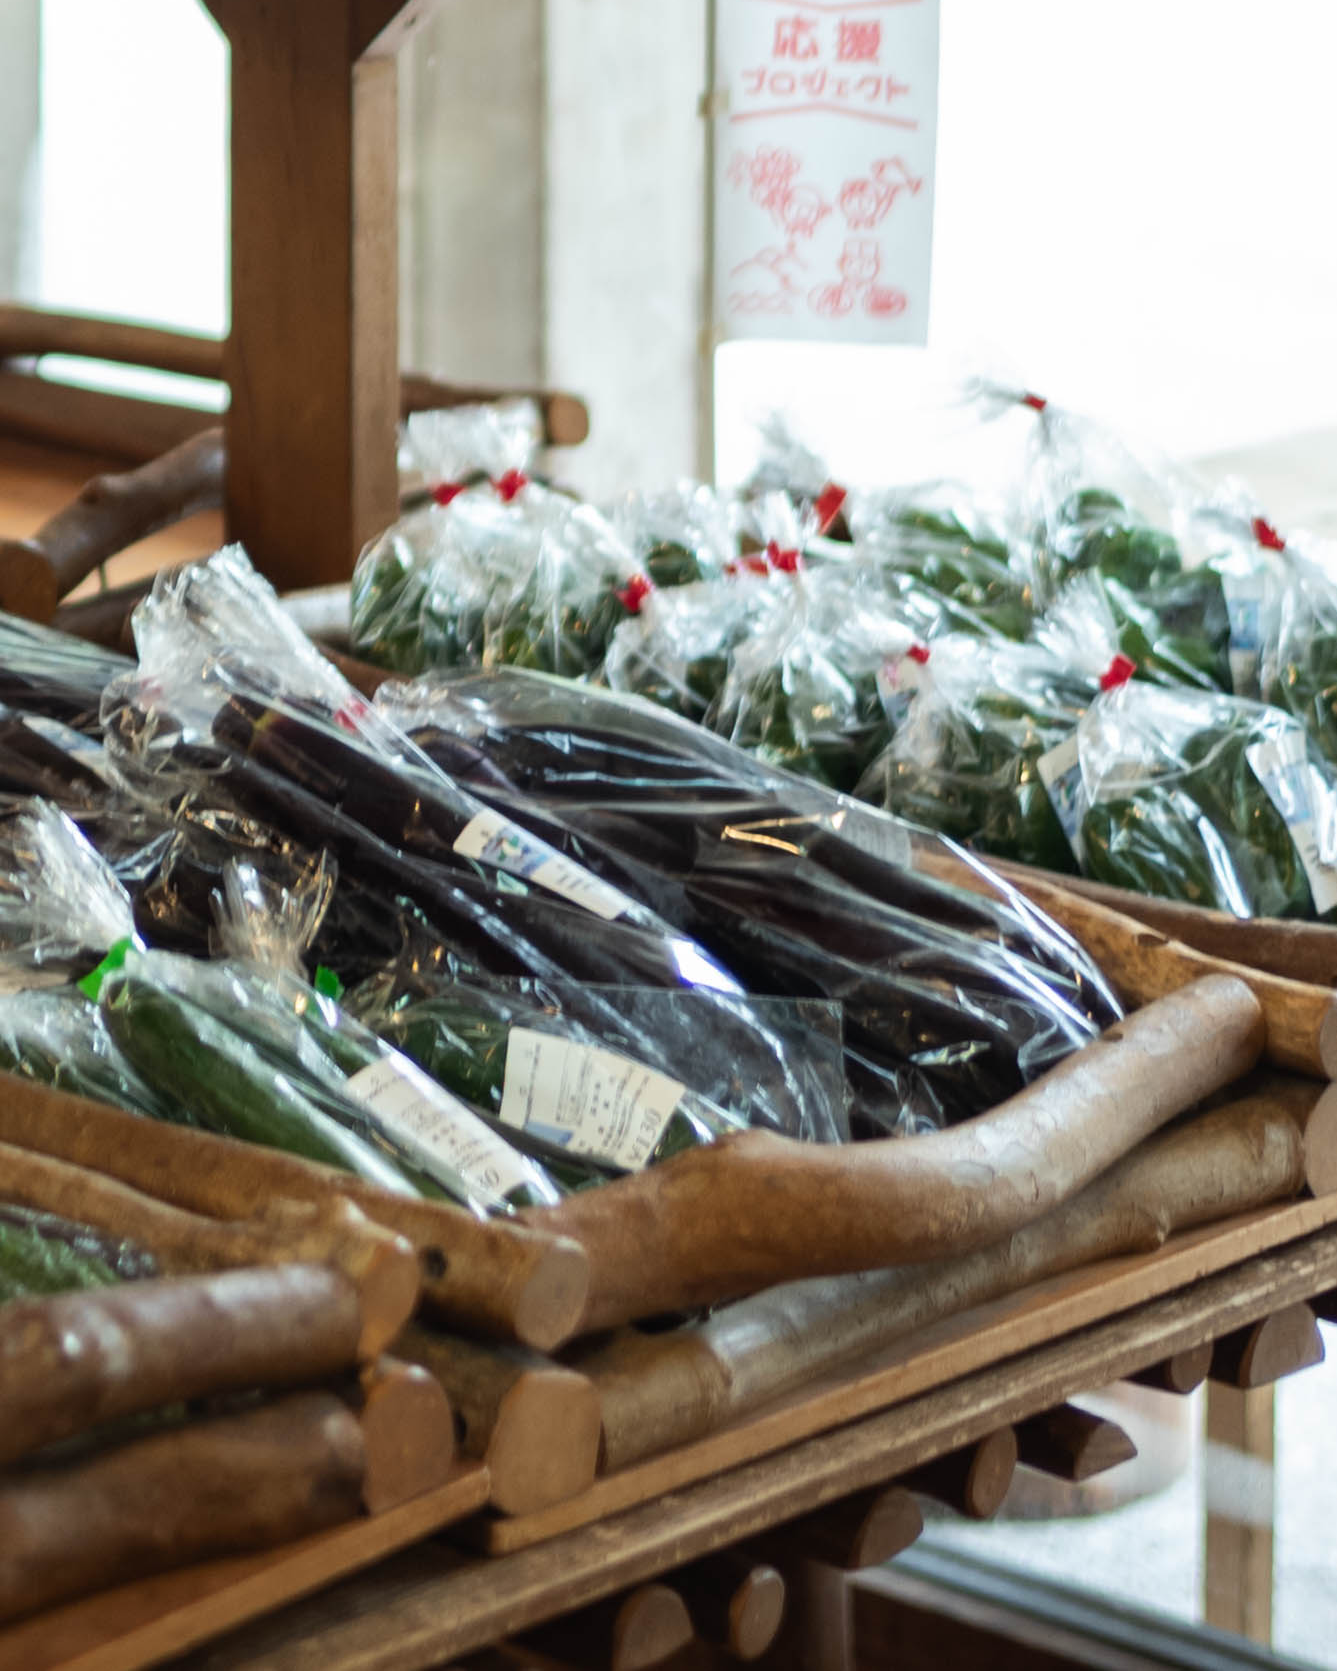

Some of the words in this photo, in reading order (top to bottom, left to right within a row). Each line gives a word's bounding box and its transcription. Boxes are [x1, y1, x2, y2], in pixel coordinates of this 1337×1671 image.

[772, 13, 884, 66] 応援
[739, 66, 912, 106] プロジェクト
